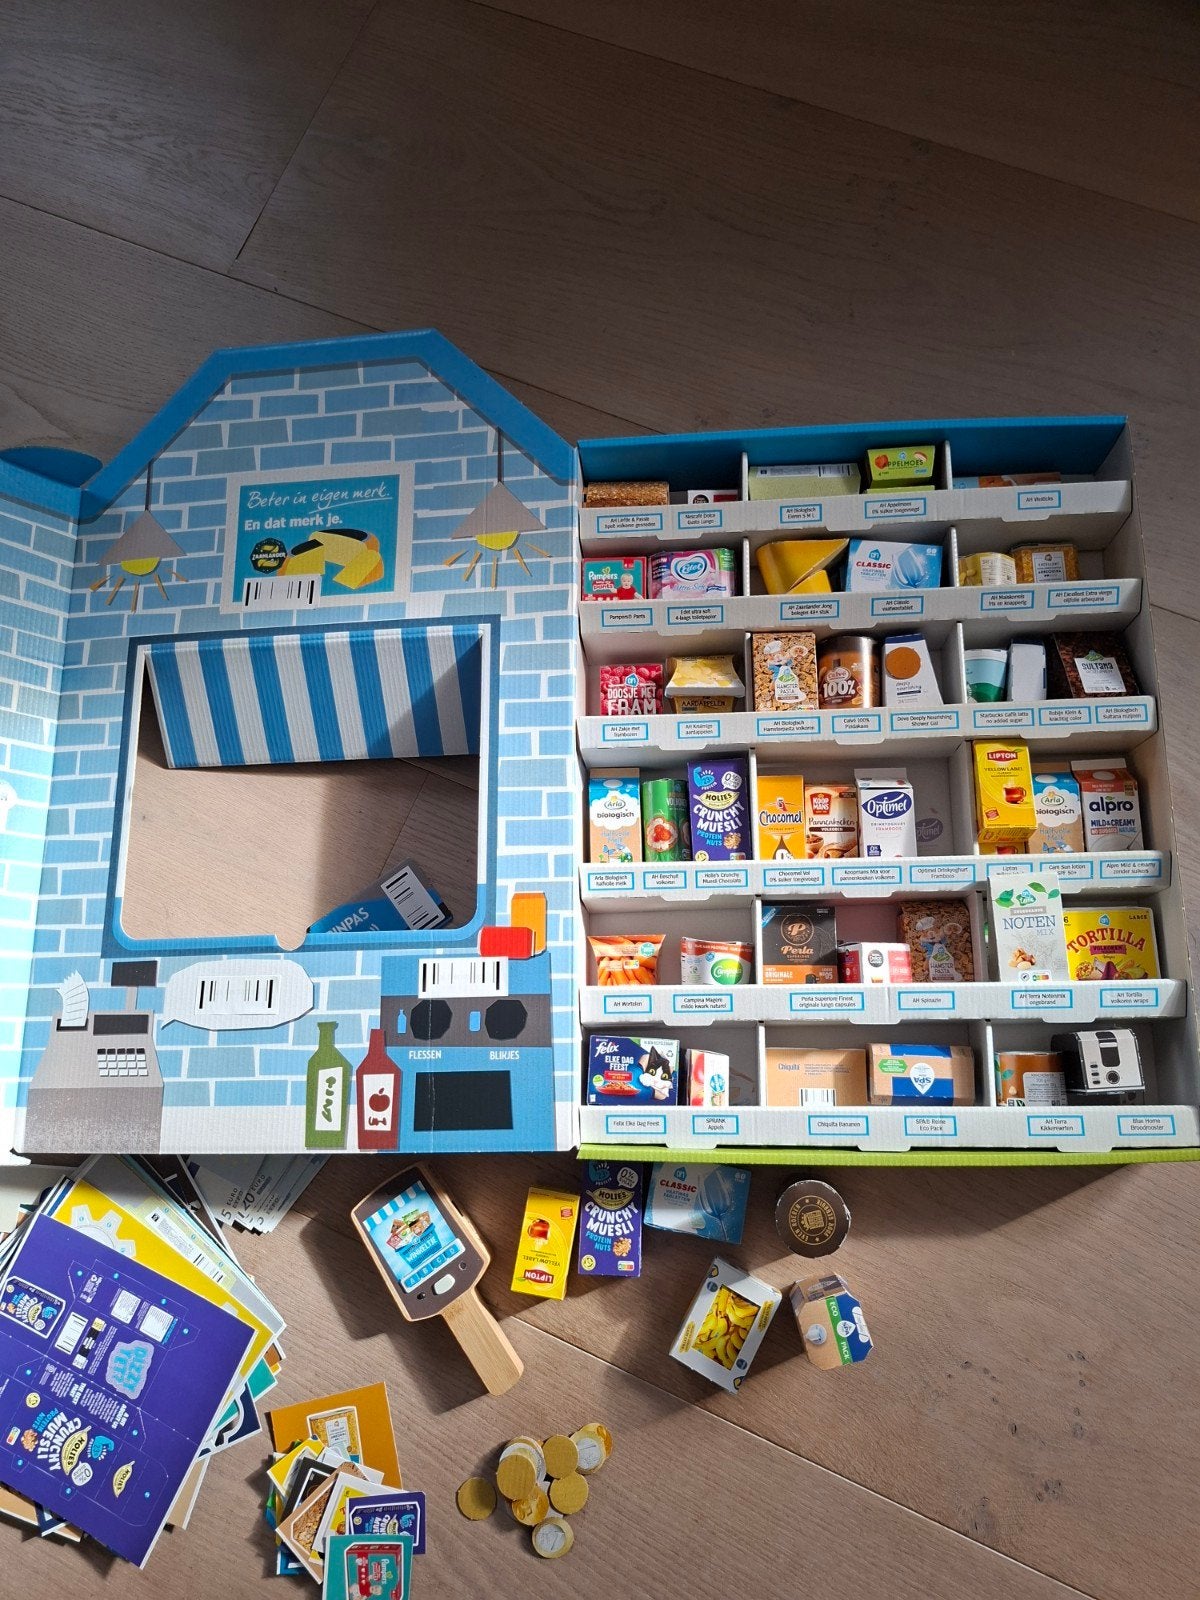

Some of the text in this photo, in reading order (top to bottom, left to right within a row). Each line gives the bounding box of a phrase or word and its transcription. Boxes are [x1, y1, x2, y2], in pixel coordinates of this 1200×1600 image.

[247, 482, 390, 509] Beter in eigen merk.
[244, 513, 343, 531] En dat merk je.
[679, 563, 702, 575] Edet
[855, 561, 892, 569] CLASSIC
[588, 571, 618, 581] Pampers
[607, 686, 657, 699] DOOSJE MET
[823, 680, 856, 698] 100%
[607, 698, 657, 716] FRAM
[988, 752, 1017, 760] LIPTON
[693, 801, 745, 823] CRUNCHY
[867, 794, 907, 817] Optimel
[1089, 797, 1134, 814] alpro
[596, 811, 634, 819] biologisch
[759, 811, 803, 826] Chocomel
[808, 817, 855, 825] Pannenkoeken
[697, 817, 743, 833] MUESLI
[697, 830, 723, 839] PROTEIN
[706, 838, 723, 846] NUTS
[1003, 915, 1056, 930] NOTEN
[1063, 916, 1069, 924] 6
[1067, 928, 1146, 954] TORTILLA
[780, 946, 814, 955] Perla
[408, 1050, 442, 1060] FLESSEN
[489, 1050, 520, 1060] BLIKJES
[594, 1041, 620, 1058] felix
[604, 1056, 620, 1064] ELKE
[609, 1062, 628, 1071] FEEST
[778, 1063, 800, 1071] Chiquita
[659, 1179, 697, 1193] CLASSIC
[226, 1187, 238, 1206] EURO
[220, 1209, 233, 1220] 5
[584, 1201, 639, 1222] CRUNCHY
[586, 1218, 635, 1237] MUESLI
[585, 1230, 612, 1244] PROTEIN
[594, 1243, 612, 1252] NUTS
[525, 1270, 553, 1283] LIPTON
[829, 1301, 851, 1360] ECO PACK
[36, 1411, 69, 1460] MUESLI
[48, 1416, 82, 1471] CRUNCHY
